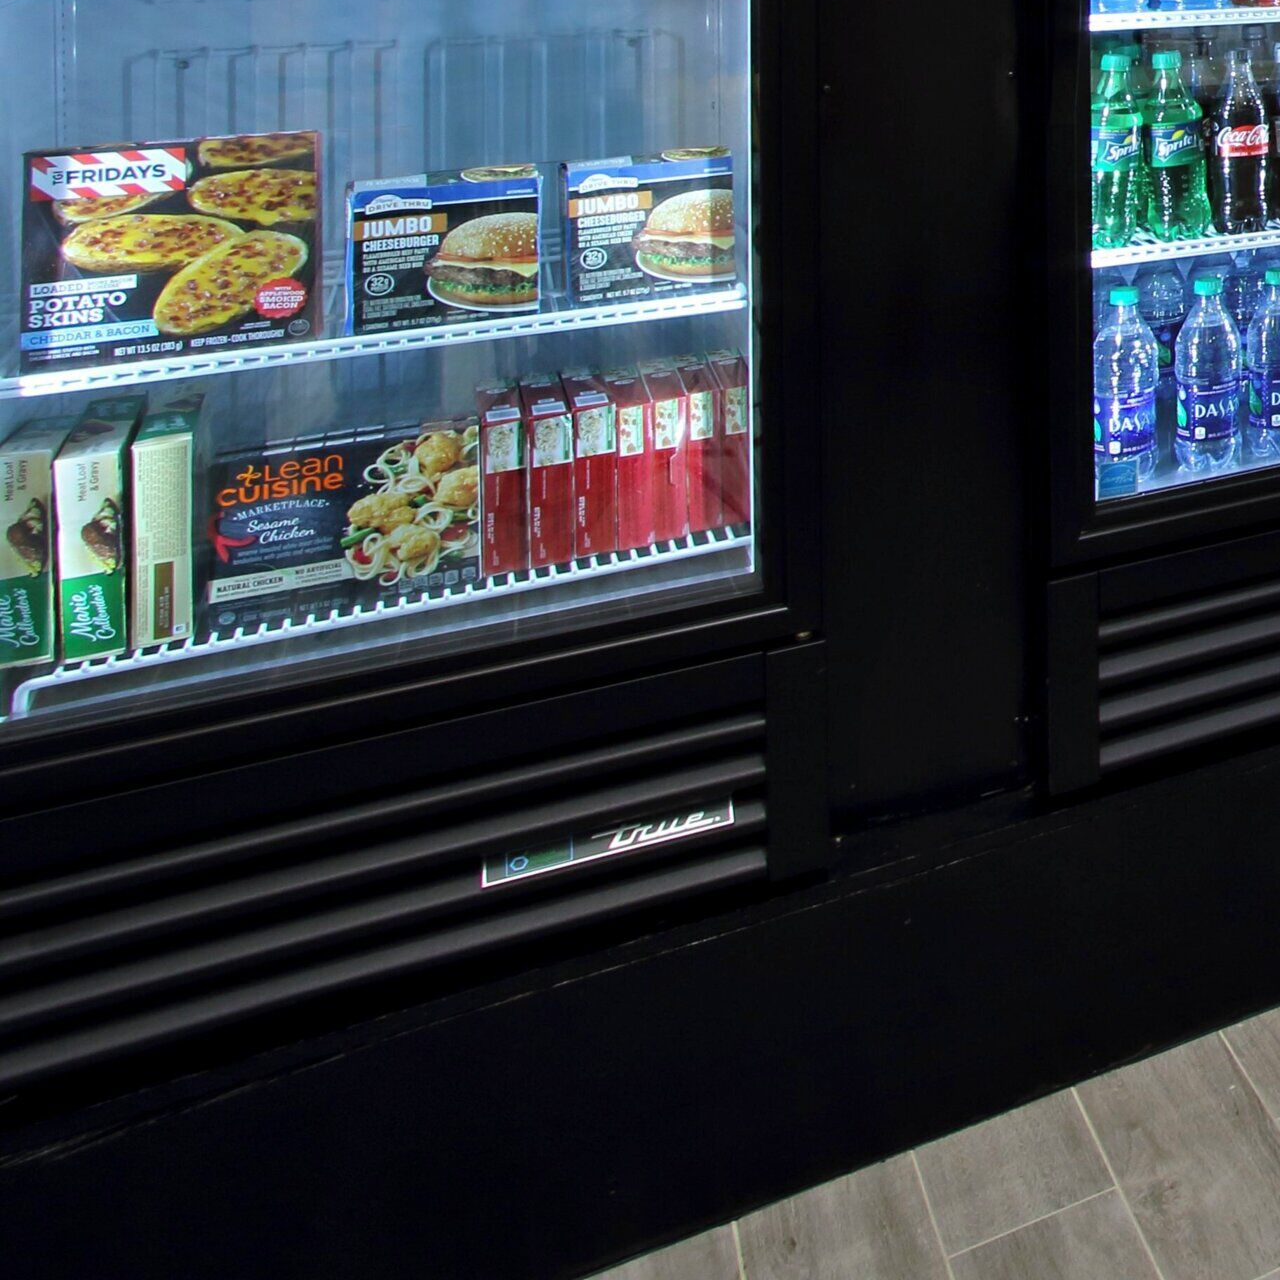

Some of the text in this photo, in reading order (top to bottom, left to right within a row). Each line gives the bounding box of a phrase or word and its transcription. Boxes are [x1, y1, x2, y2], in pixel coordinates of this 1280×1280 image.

[1158, 135, 1194, 157] Sprite
[52, 164, 166, 186] TGI FRIDAYS
[368, 203, 399, 212] DRIVE
[577, 193, 638, 216] JUMBO
[362, 216, 432, 238] JUMBO
[578, 210, 646, 228] CHEESEBURGER
[363, 235, 439, 252] CHEESEBURGER
[33, 283, 83, 295] LOADED
[30, 291, 127, 314] POTATO
[28, 309, 104, 328] SKINS
[30, 325, 150, 346] CHEDDAR & BACON
[90, 461, 100, 484] Gravy
[265, 454, 343, 482] Lean
[5, 480, 13, 501] Meat
[78, 481, 86, 502] Meat
[237, 499, 325, 520] MARKETPLACE
[246, 517, 299, 533] Sesame
[259, 528, 315, 544] Chicken
[217, 576, 283, 593] NATURAL CHICKEN
[69, 591, 96, 642] Marie
[89, 584, 116, 639] Callender's
